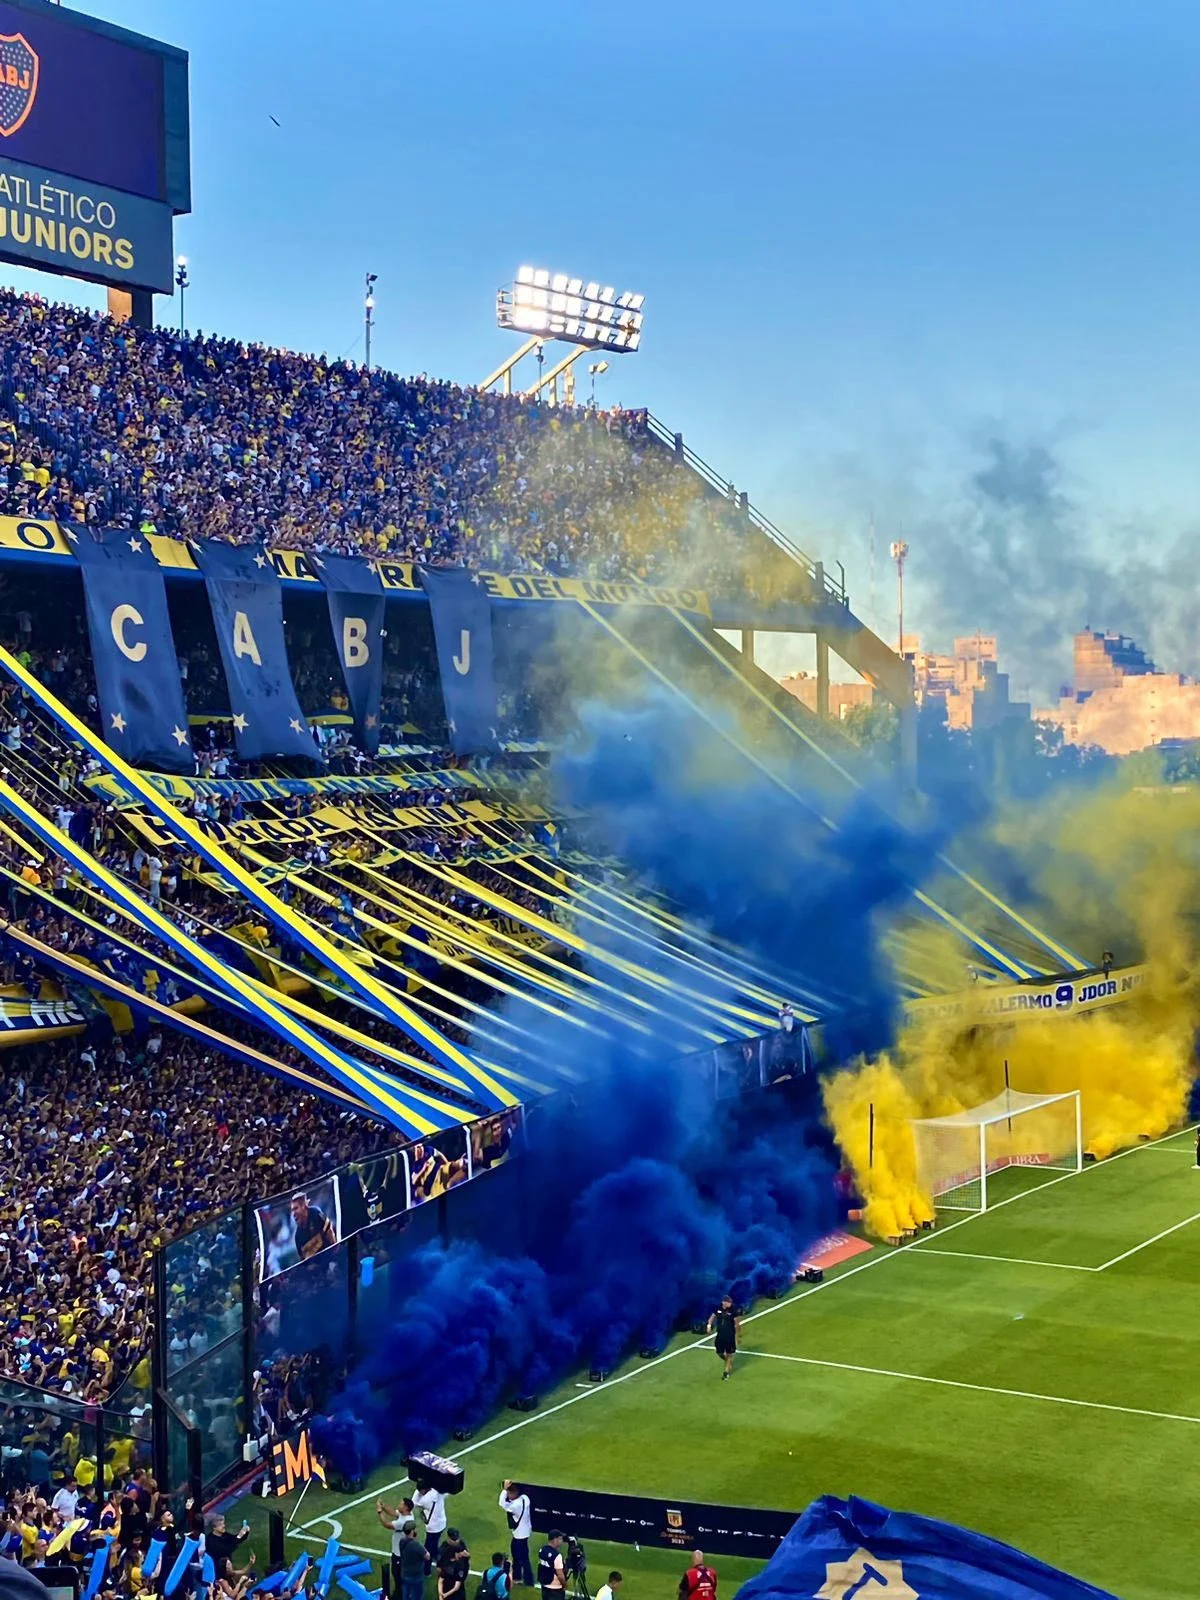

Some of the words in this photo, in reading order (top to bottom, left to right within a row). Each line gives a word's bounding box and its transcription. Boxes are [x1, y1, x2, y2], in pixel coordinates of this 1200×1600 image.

[0, 173, 116, 229] ATLÉTICO
[0, 206, 135, 270] JUNIORS
[509, 578, 577, 599] DEL
[110, 603, 148, 662] C
[233, 611, 262, 666] A
[343, 617, 370, 668] B
[453, 630, 470, 675] J
[407, 804, 478, 825] UNA
